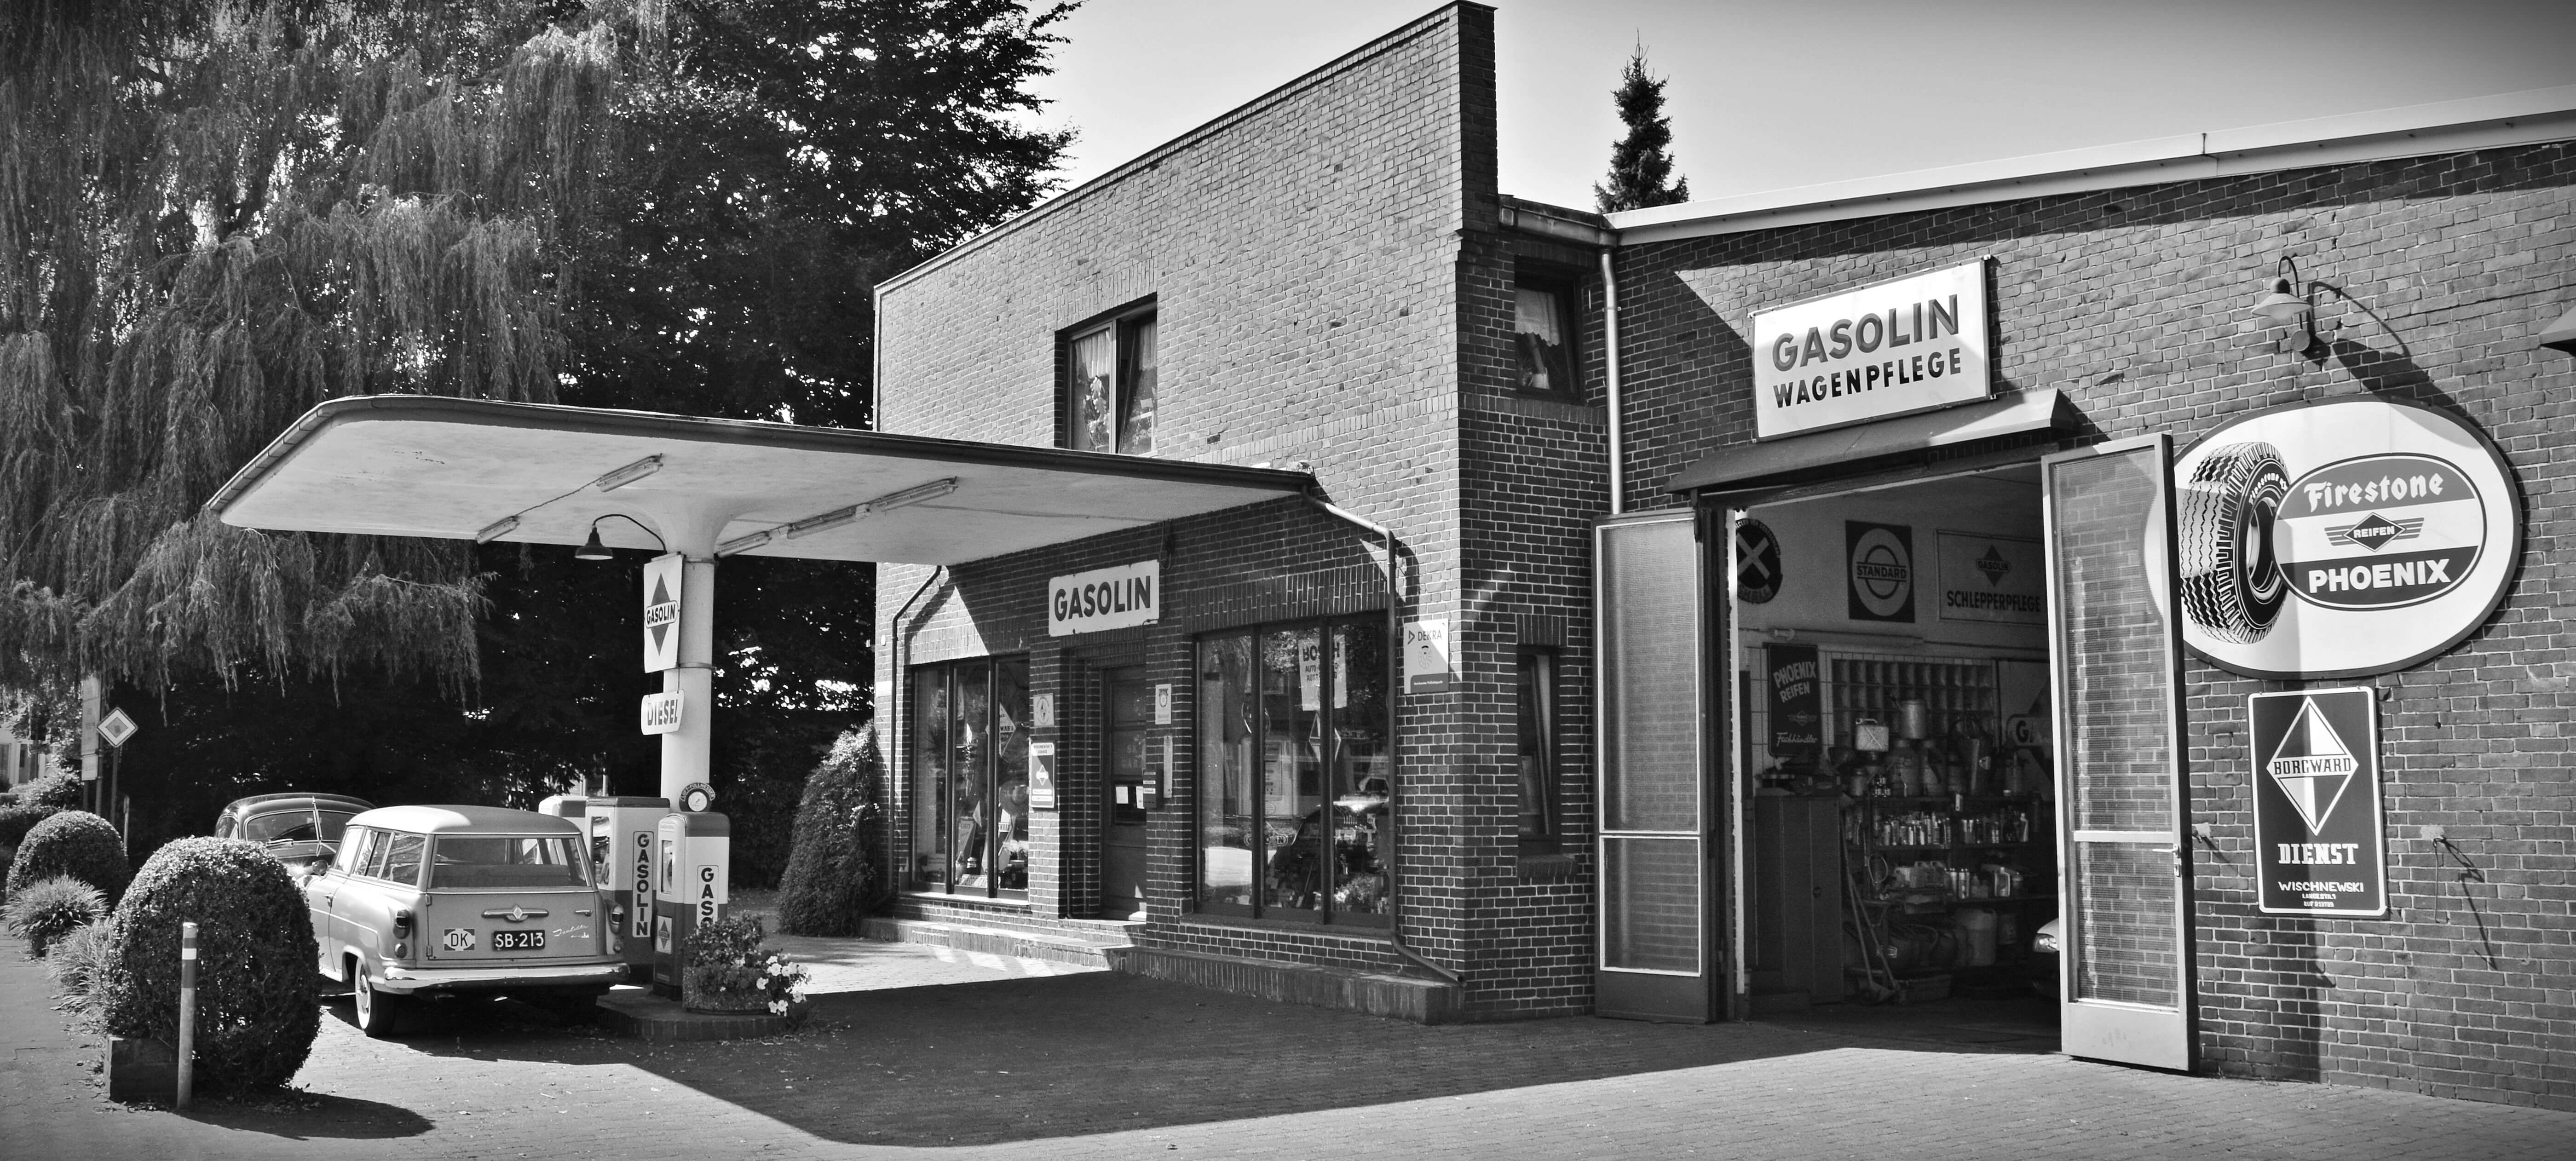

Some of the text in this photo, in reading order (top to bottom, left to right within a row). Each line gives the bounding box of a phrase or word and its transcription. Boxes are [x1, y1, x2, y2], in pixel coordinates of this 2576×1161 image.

[1772, 293, 1959, 372] GASOLIN
[1773, 347, 1962, 408] WAGENPFLEGE
[2303, 472, 2444, 513] Firestone
[2352, 525, 2396, 539] REIFEN
[1856, 563, 1907, 580] STANDARD
[1978, 560, 2011, 572] GASOLIN
[2308, 558, 2451, 594] PHOENIX
[1054, 575, 1152, 622] GASOLIN
[1947, 590, 2041, 612] SCHLEPPERPFLEGE
[646, 603, 675, 625] GASOLIN
[1418, 629, 1442, 642] DEKRA
[1773, 661, 1816, 689] PHOENIX
[1779, 681, 1810, 703] REIFEN
[647, 699, 678, 726] DIESEL
[1776, 732, 1817, 747] Fachhändler
[2273, 757, 2351, 776] BORGWARD
[2277, 843, 2359, 865] DIENST
[636, 833, 650, 936] GASOLIN
[2278, 881, 2364, 892] WISCHNEWSKI
[450, 933, 468, 947] DK
